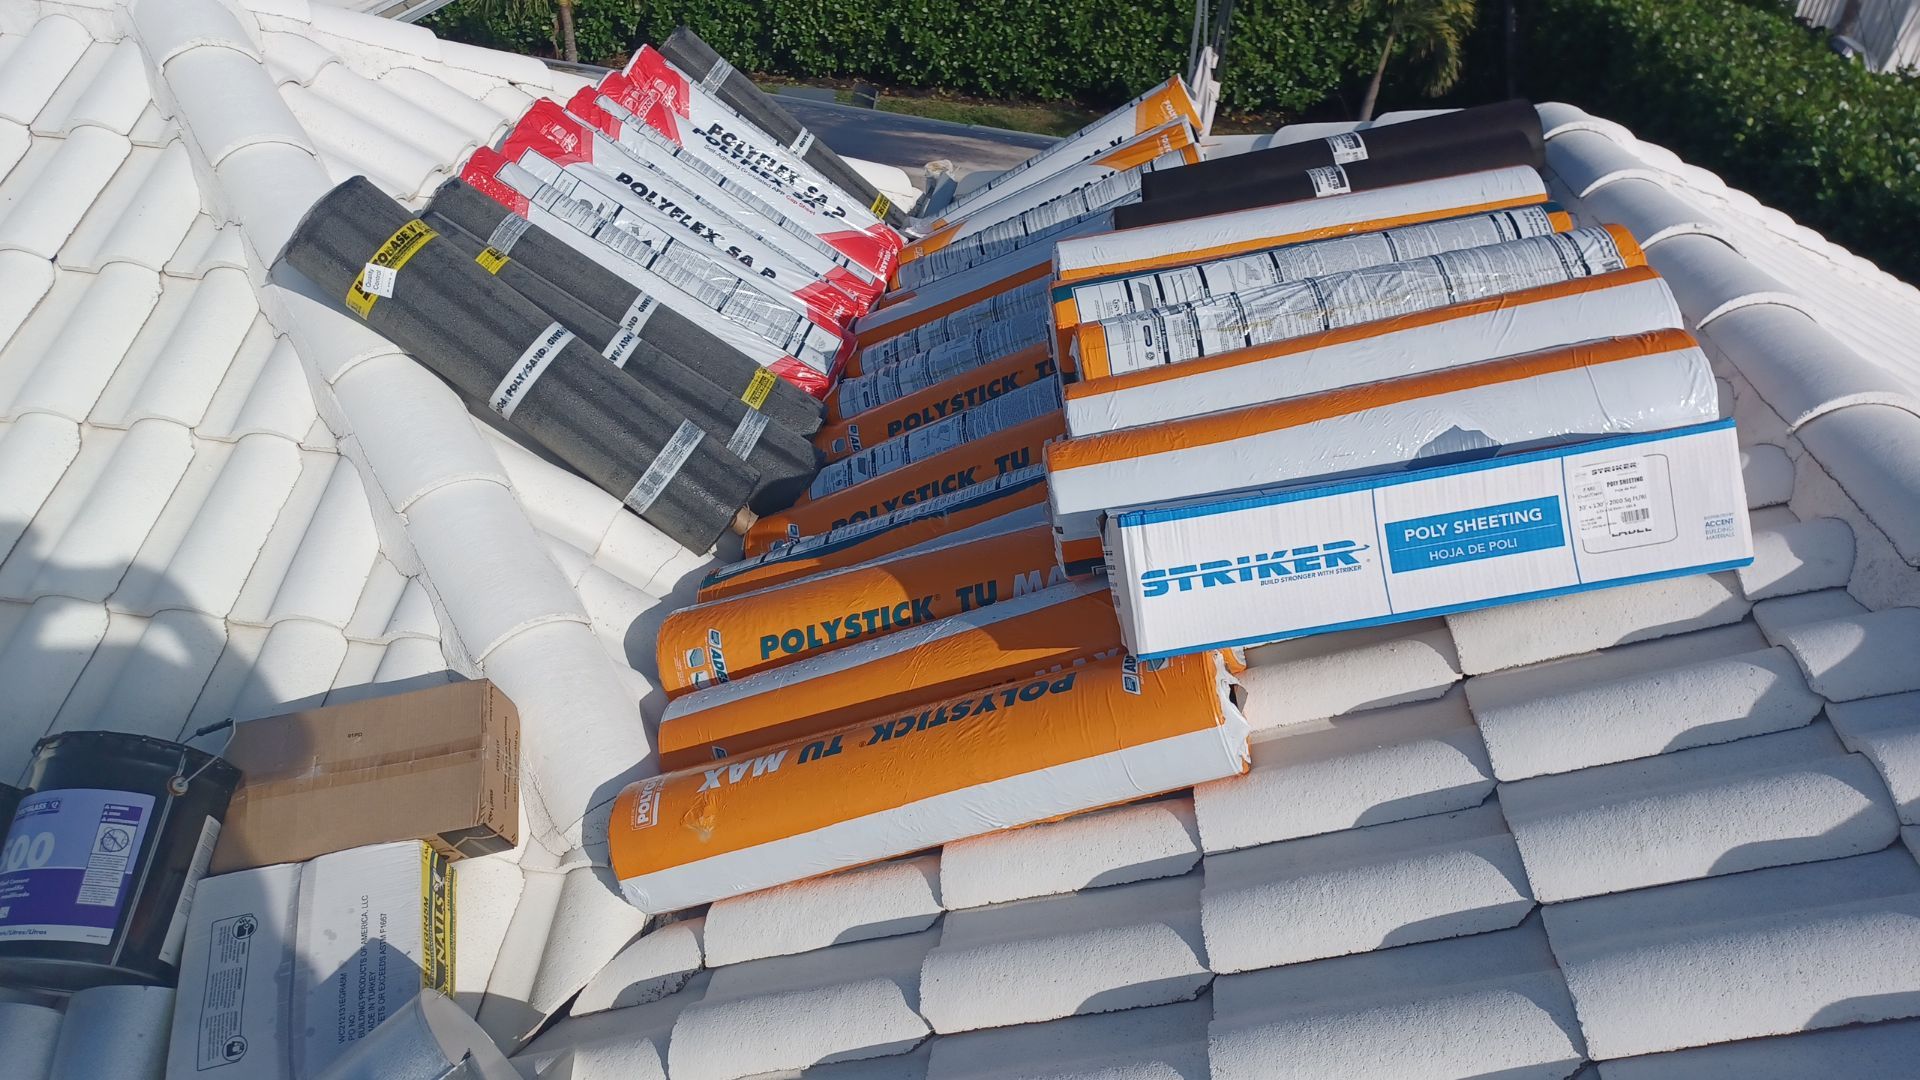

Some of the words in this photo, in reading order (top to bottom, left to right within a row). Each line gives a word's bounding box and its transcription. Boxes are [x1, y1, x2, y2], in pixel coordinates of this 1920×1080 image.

[615, 172, 721, 245] POLYFLEX
[726, 246, 755, 268] SA
[760, 267, 777, 280] P
[366, 269, 375, 288] Quality
[372, 270, 381, 290] Control
[887, 371, 1021, 438] POLYSTICK
[994, 447, 1030, 475] TU
[1591, 462, 1637, 476] STRIKER
[1404, 523, 1449, 542] POLY
[1453, 507, 1543, 534] SHEETING
[1705, 517, 1734, 527] ACCENT
[1429, 547, 1465, 562] HOJA
[1468, 543, 1486, 554] DE
[1489, 537, 1518, 552] POLI
[1141, 539, 1370, 598] STRIKER
[1260, 578, 1280, 587] BUILD
[1280, 572, 1317, 583] STRONGER
[1317, 568, 1334, 577] WITH
[1335, 564, 1362, 575] STRIKER
[760, 594, 936, 660] POLYSTICK
[955, 579, 998, 614] TU
[1012, 565, 1068, 599] MA
[866, 671, 1077, 746] POLYSTICK
[797, 734, 844, 765] TU
[696, 749, 790, 793] MAX
[361, 894, 369, 909] LLC
[435, 895, 446, 962] NAILS
[360, 947, 368, 957] OF
[379, 934, 387, 956] ASTM
[359, 958, 367, 998] PRODUCTS
[368, 971, 376, 1003] TURKEY
[378, 956, 386, 992] EXCEEDS
[368, 1004, 375, 1013] IN
[378, 993, 386, 1005] OR
[358, 1000, 366, 1040] BUILDING
[348, 1028, 356, 1042] PO
